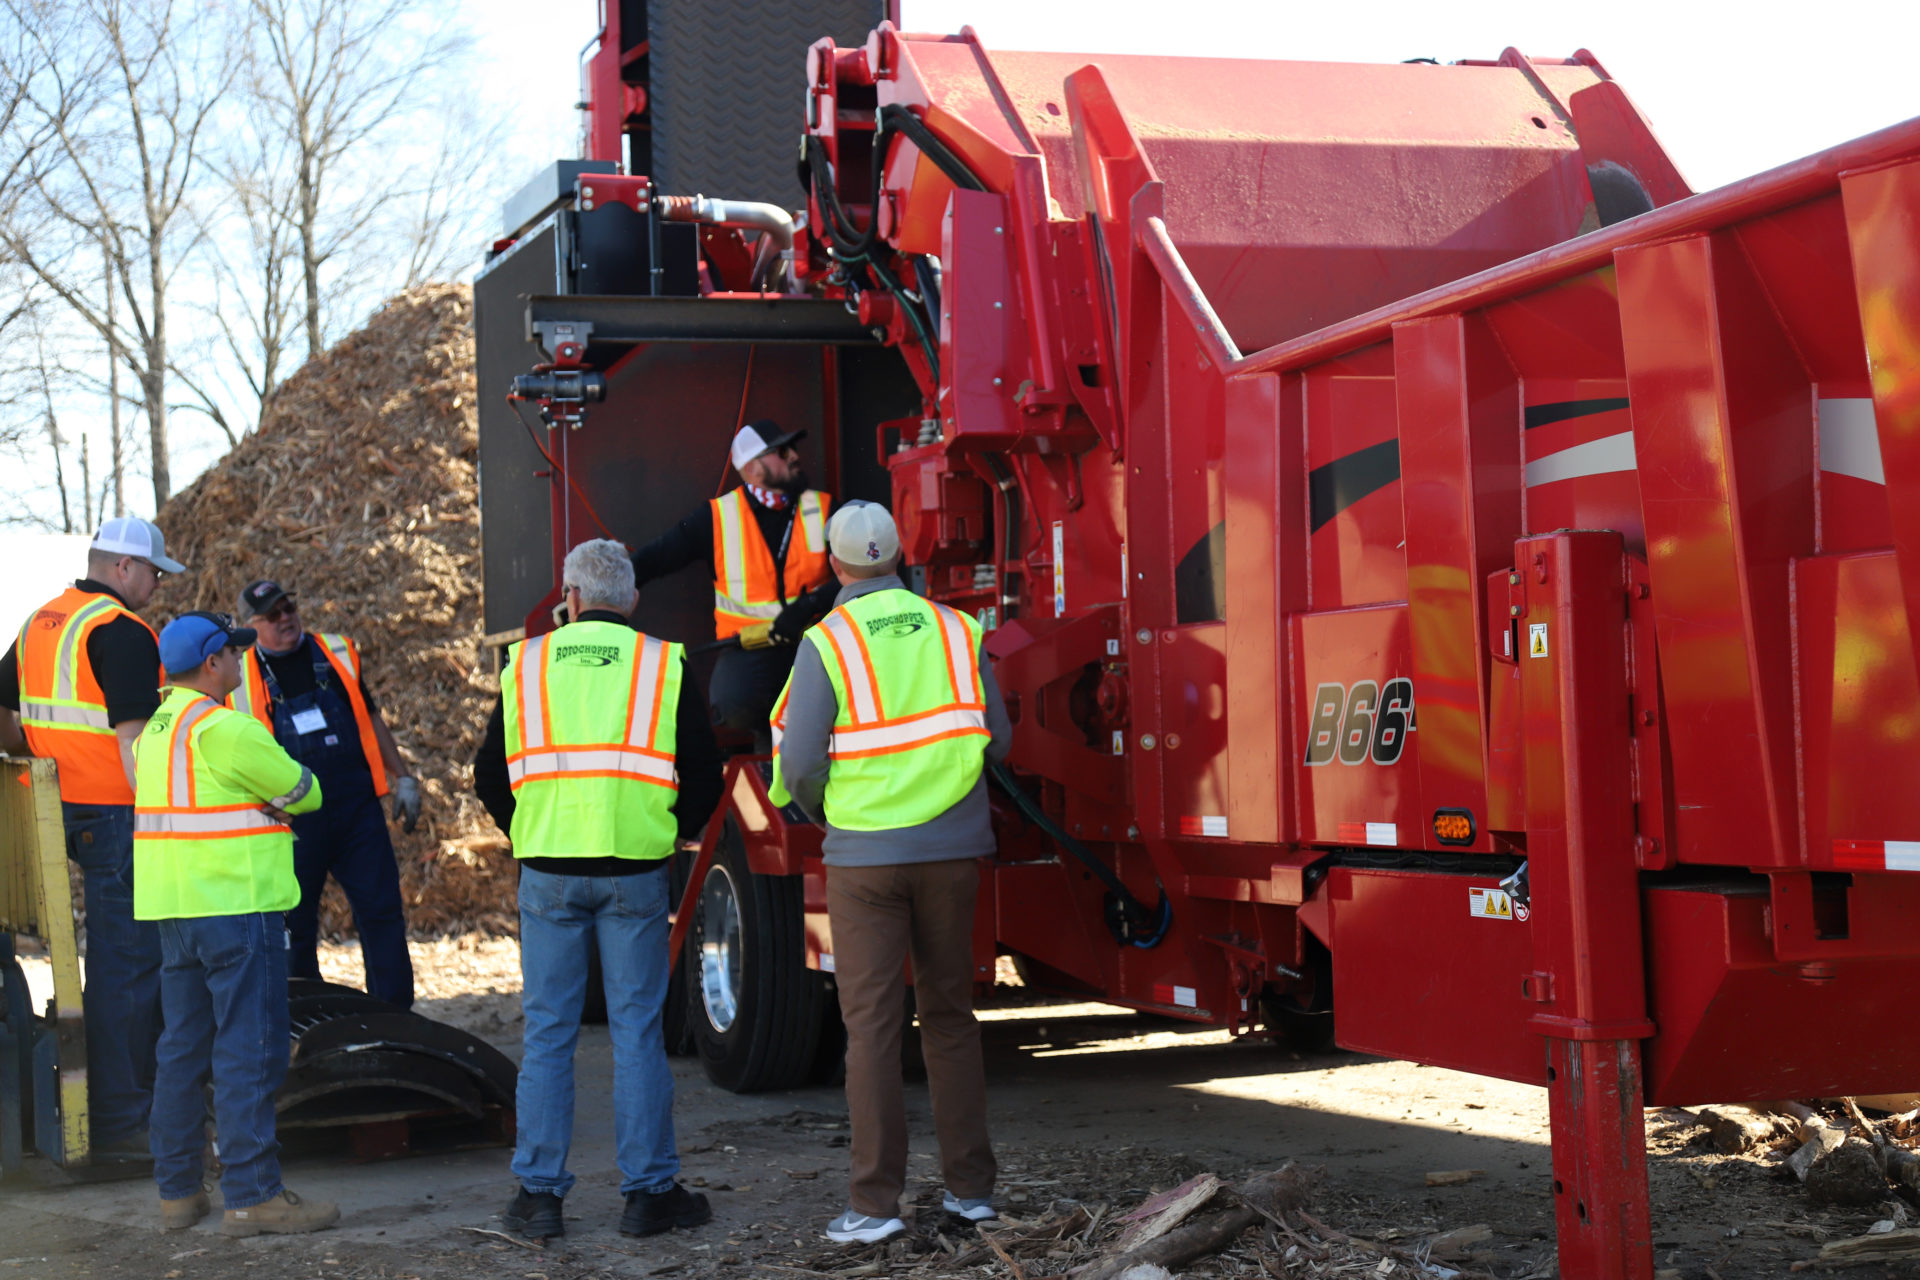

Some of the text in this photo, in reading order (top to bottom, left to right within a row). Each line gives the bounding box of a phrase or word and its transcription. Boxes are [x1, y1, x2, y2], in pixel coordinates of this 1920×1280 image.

[866, 612, 928, 636] ROTOCHOPPER
[555, 644, 620, 662] ROTOCHOPPER
[1303, 677, 1417, 767] B66
